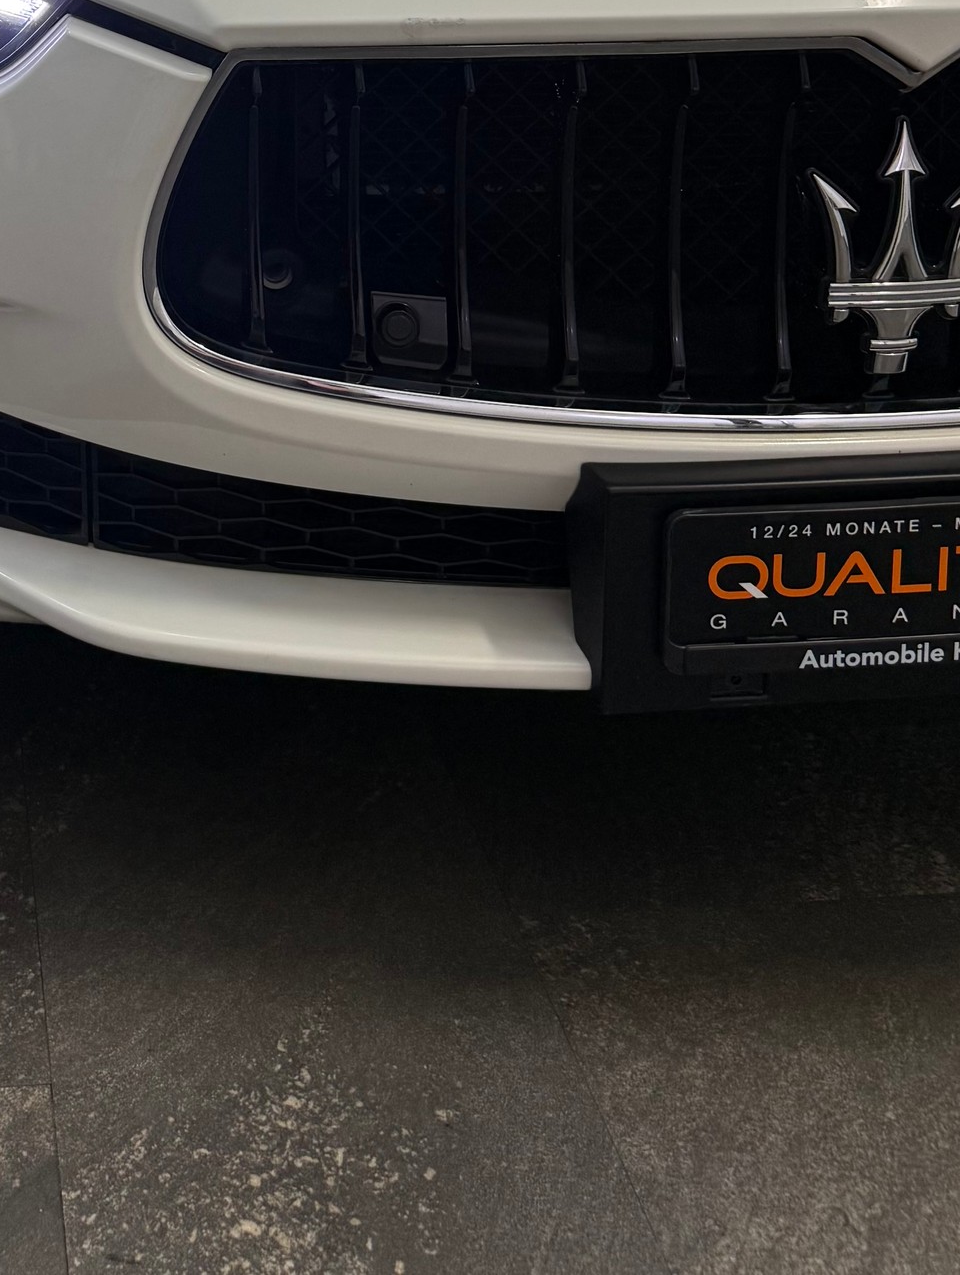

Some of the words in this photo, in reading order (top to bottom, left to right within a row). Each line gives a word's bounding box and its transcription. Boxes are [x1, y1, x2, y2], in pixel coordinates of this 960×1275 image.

[750, 524, 813, 540] 12/24
[826, 519, 920, 537] MONATE
[708, 546, 960, 600] QUALI
[799, 642, 945, 669] Automobile
